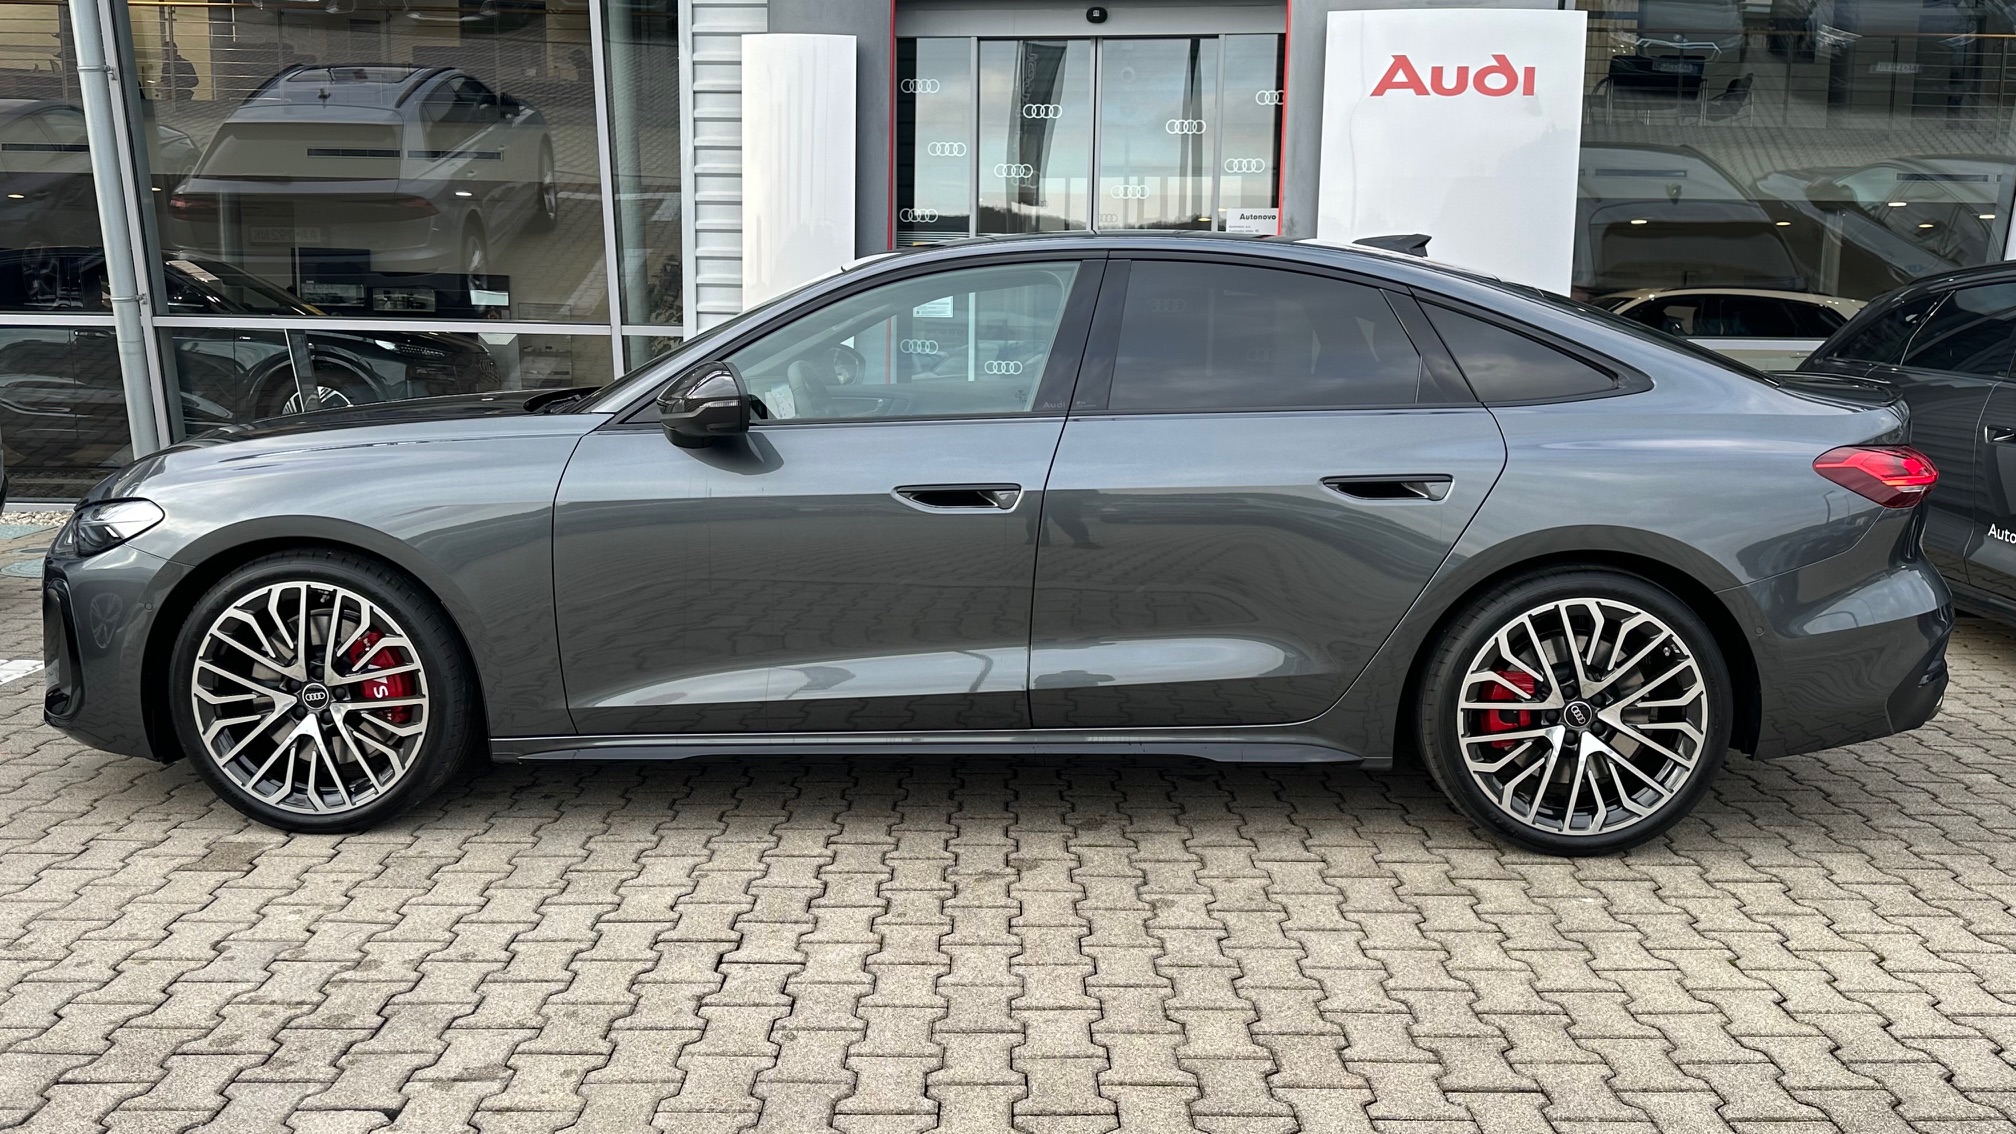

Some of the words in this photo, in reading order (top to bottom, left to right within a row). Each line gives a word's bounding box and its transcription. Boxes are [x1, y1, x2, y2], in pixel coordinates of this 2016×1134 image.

[1370, 54, 1536, 97] Audi
[1043, 401, 1066, 409] Audi
[1987, 523, 2016, 544] Auto
